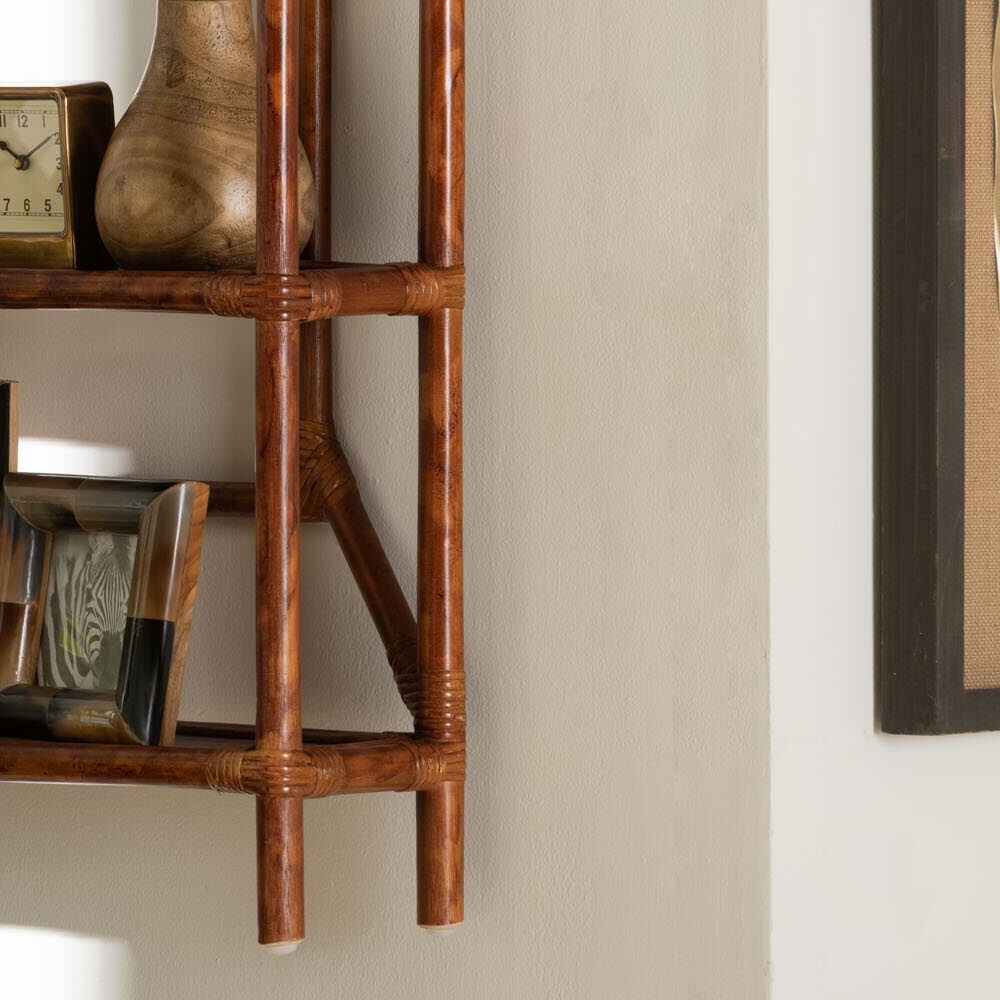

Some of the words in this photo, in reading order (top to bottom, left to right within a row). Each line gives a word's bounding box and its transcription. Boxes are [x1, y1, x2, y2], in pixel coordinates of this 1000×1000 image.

[17, 114, 29, 128] 12
[54, 131, 61, 145] 2
[55, 157, 62, 170] 3
[56, 182, 63, 195] 4
[3, 198, 11, 212] 7
[23, 198, 31, 212] 6
[44, 198, 52, 212] 5
